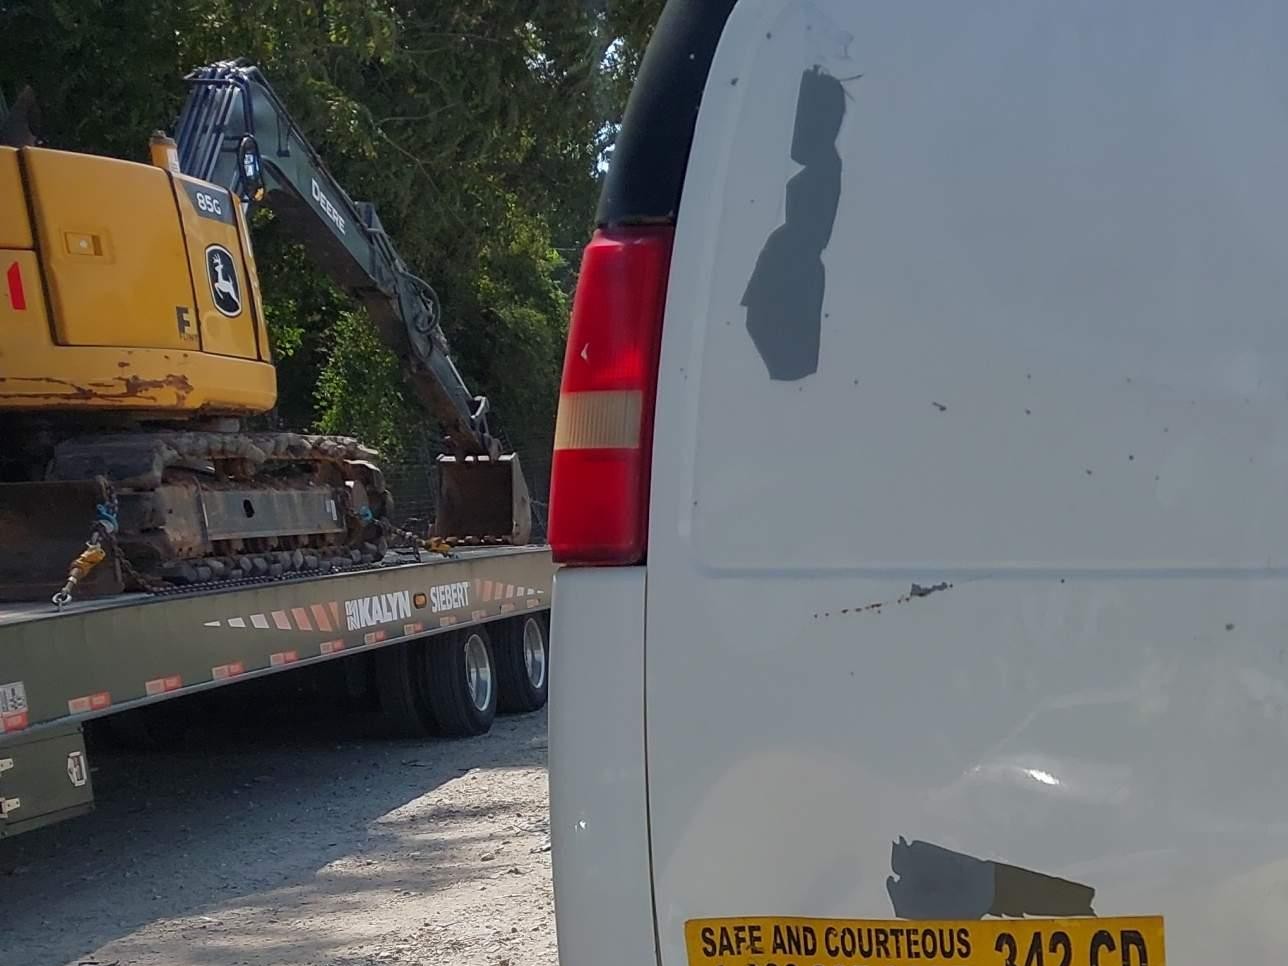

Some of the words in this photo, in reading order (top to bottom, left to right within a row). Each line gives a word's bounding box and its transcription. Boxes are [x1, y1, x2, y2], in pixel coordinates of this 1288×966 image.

[196, 193, 222, 215] 85G
[311, 178, 346, 235] DEERE
[358, 590, 411, 627] KALYN
[430, 582, 469, 613] SIEBERT
[701, 926, 764, 957] SAFE
[772, 925, 816, 957] AND
[824, 927, 973, 959] COURTEOUS
